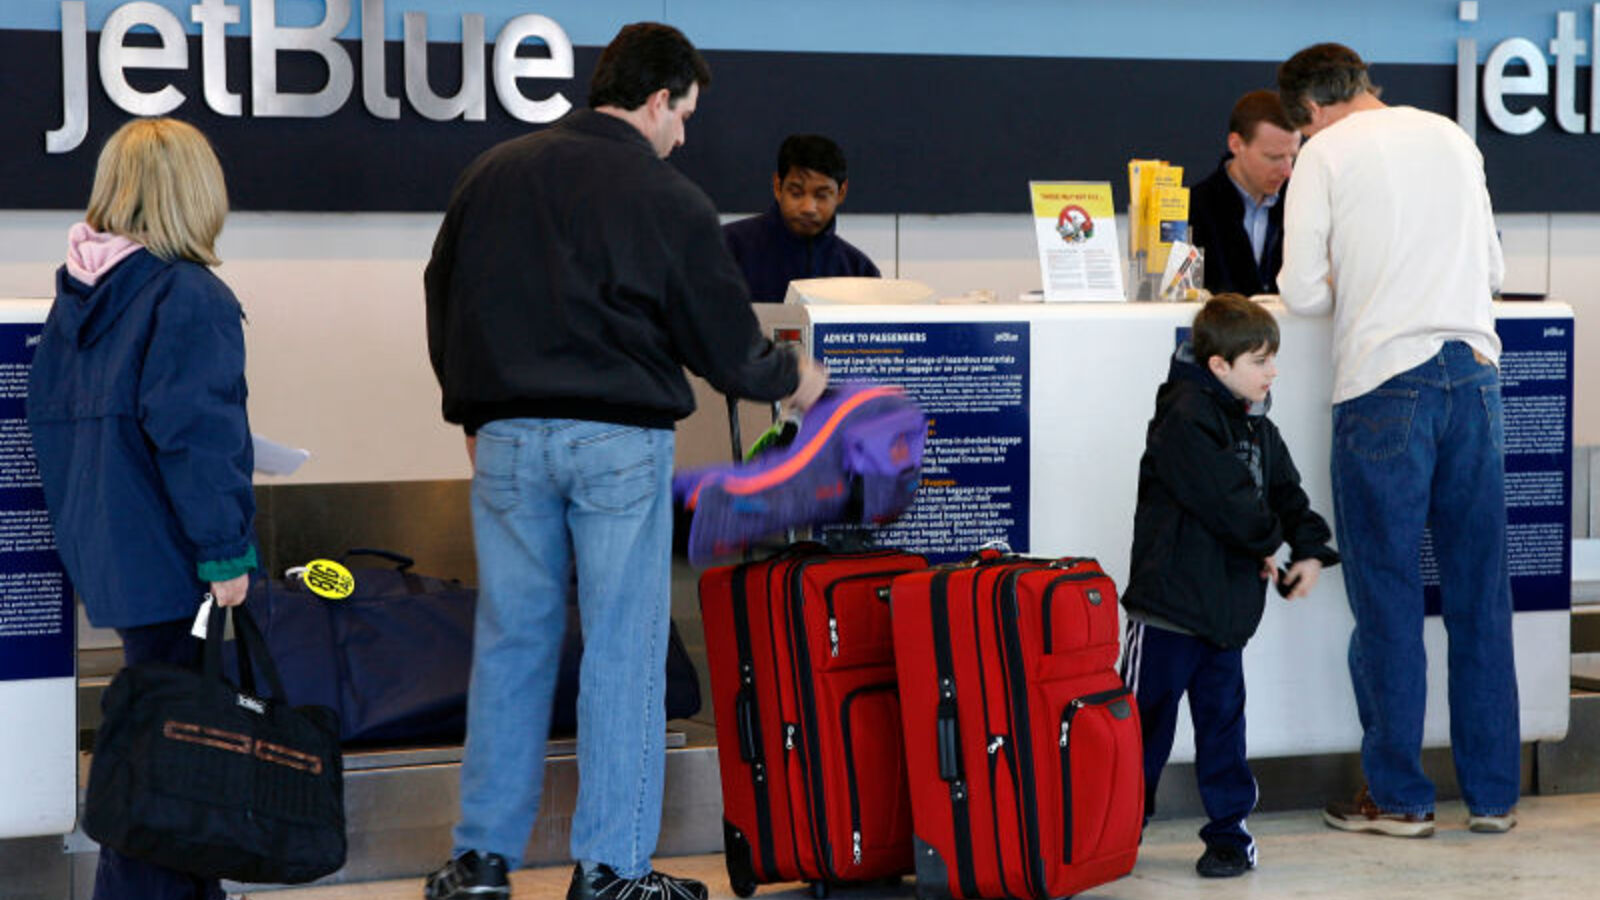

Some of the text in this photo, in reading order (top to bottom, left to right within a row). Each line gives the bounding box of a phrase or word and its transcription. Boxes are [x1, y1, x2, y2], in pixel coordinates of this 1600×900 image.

[46, 0, 574, 153] jetBlue
[1457, 1, 1600, 146] jet
[823, 332, 927, 344] ADVICE TO PASSENGERS
[893, 356, 905, 365] the
